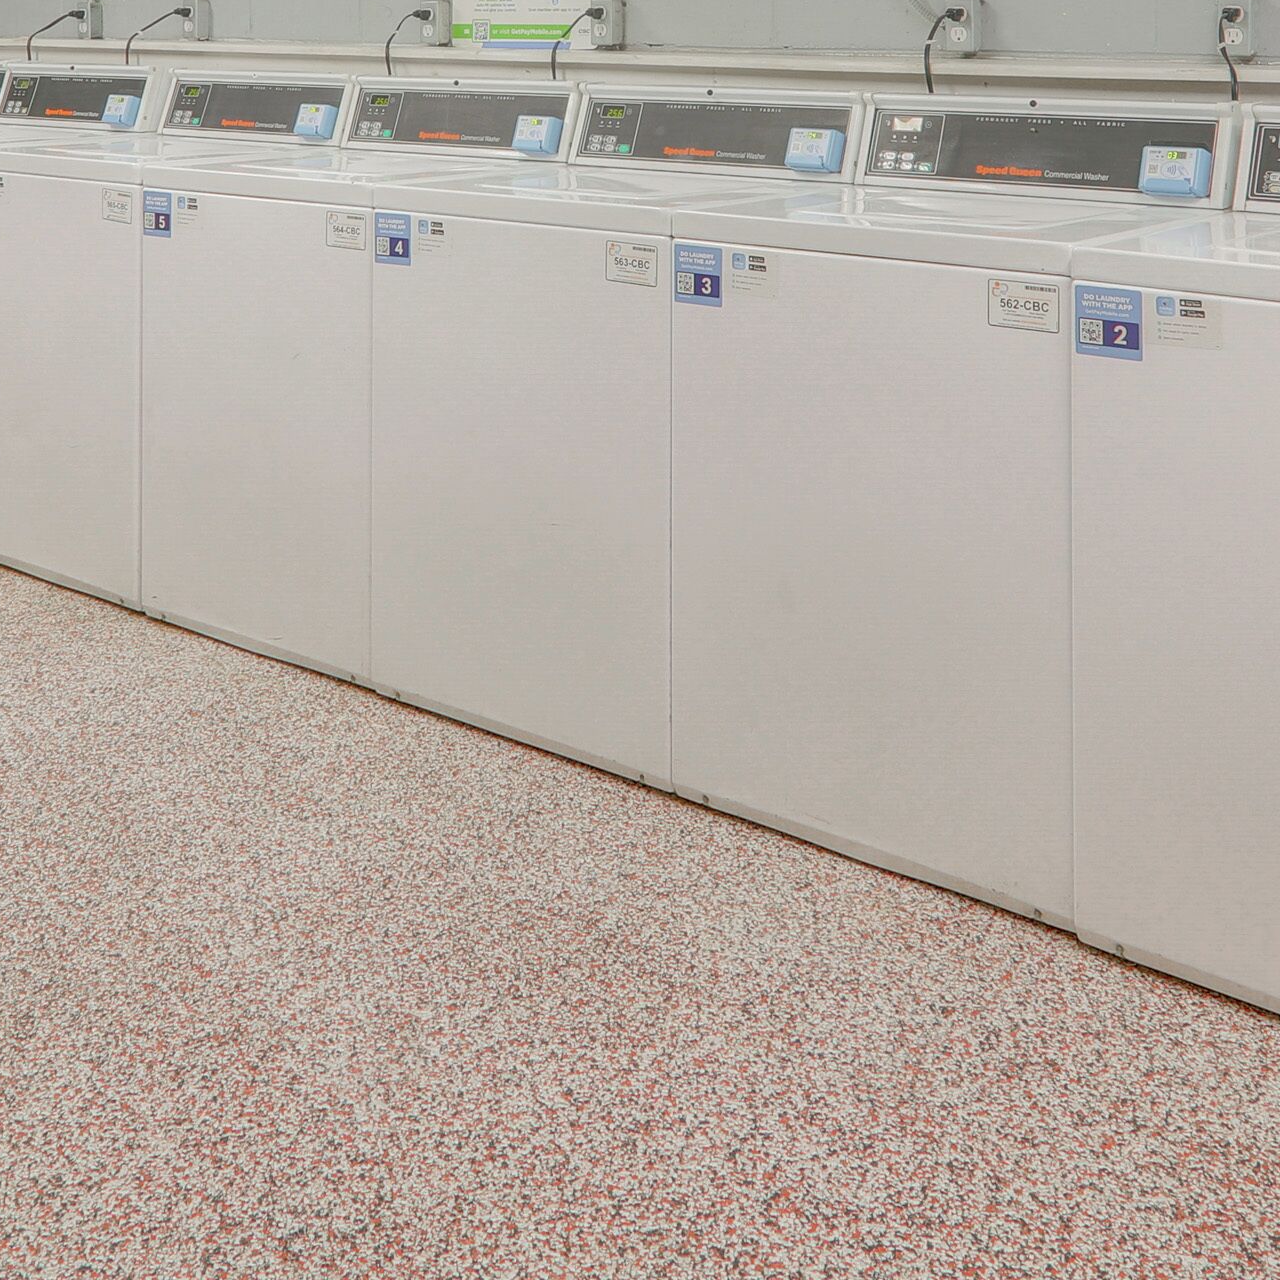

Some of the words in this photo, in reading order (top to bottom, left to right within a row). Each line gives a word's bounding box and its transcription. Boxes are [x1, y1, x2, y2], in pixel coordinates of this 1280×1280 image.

[607, 108, 624, 117] 256
[663, 145, 689, 156] Speed
[716, 150, 746, 159] Commercial
[746, 151, 767, 160] Washer
[1167, 151, 1178, 160] 03
[976, 165, 1009, 175] Speed
[1009, 166, 1042, 177] Queen
[1044, 170, 1083, 180] Commercial
[1084, 172, 1109, 182] Washer
[159, 216, 166, 229] 5
[333, 225, 361, 236] 564-CBC
[394, 240, 403, 255] 4
[614, 256, 650, 270] 563-CBC
[701, 277, 712, 295] 3
[1000, 298, 1049, 313] 562-CBC
[1081, 299, 1101, 308] WITH
[1102, 301, 1117, 310] THE
[1118, 303, 1134, 312] APP
[1095, 294, 1132, 304] LAUNDRY
[1113, 325, 1128, 346] 2
